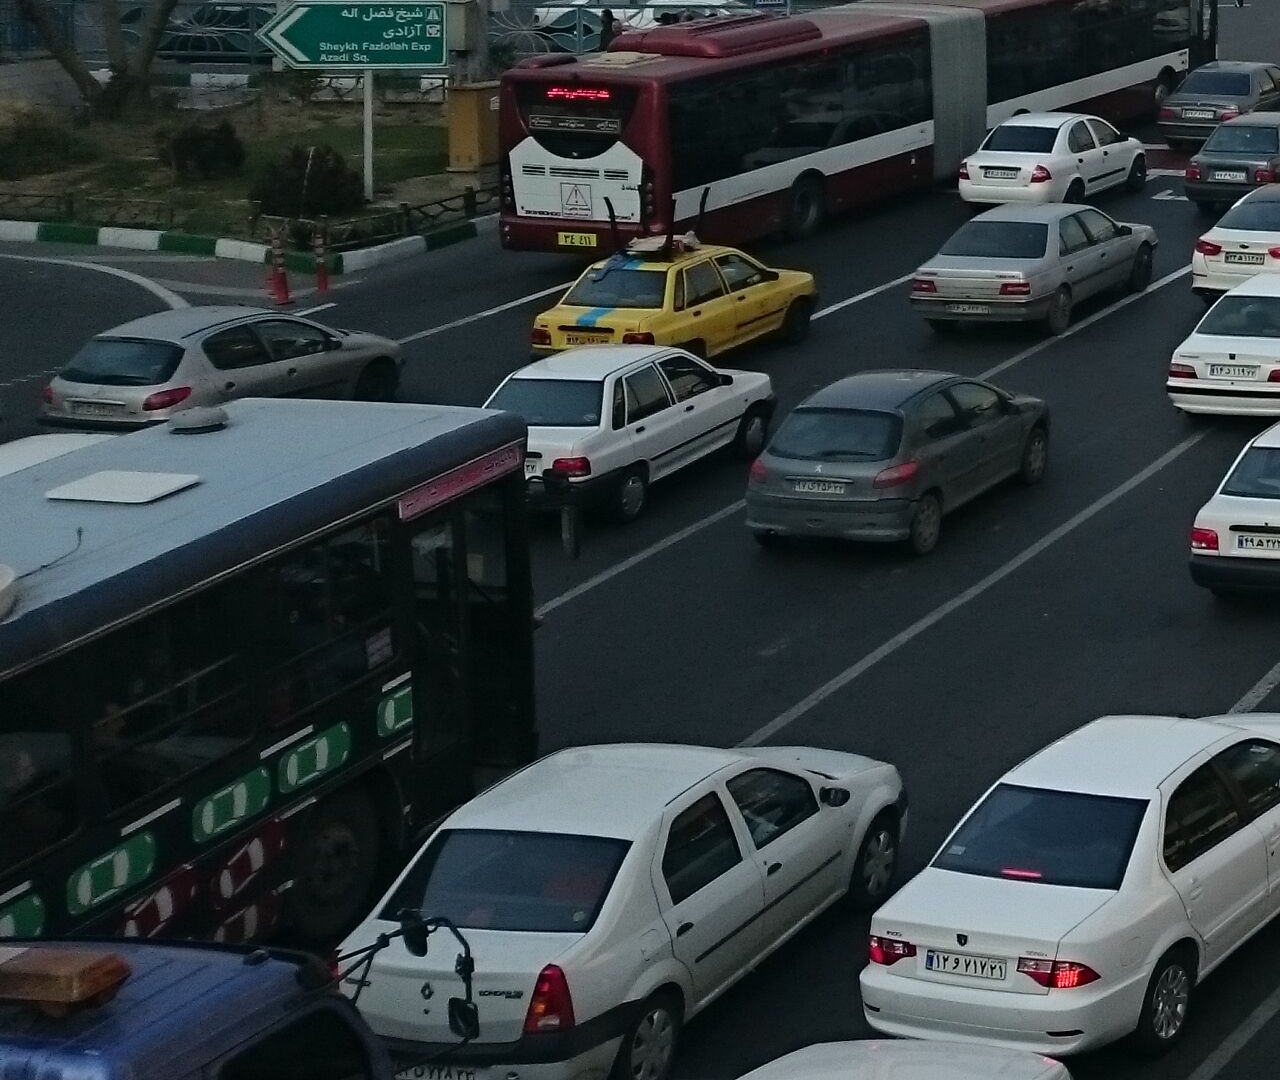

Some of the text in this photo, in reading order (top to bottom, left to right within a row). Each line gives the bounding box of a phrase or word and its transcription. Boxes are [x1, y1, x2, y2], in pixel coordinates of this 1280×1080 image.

[361, 6, 395, 22] فضل
[396, 7, 423, 21] شیخ
[383, 23, 423, 39] آزادی
[319, 41, 431, 53] Sheykh Fazlollah Exp
[319, 52, 370, 64] Azadi Sq.
